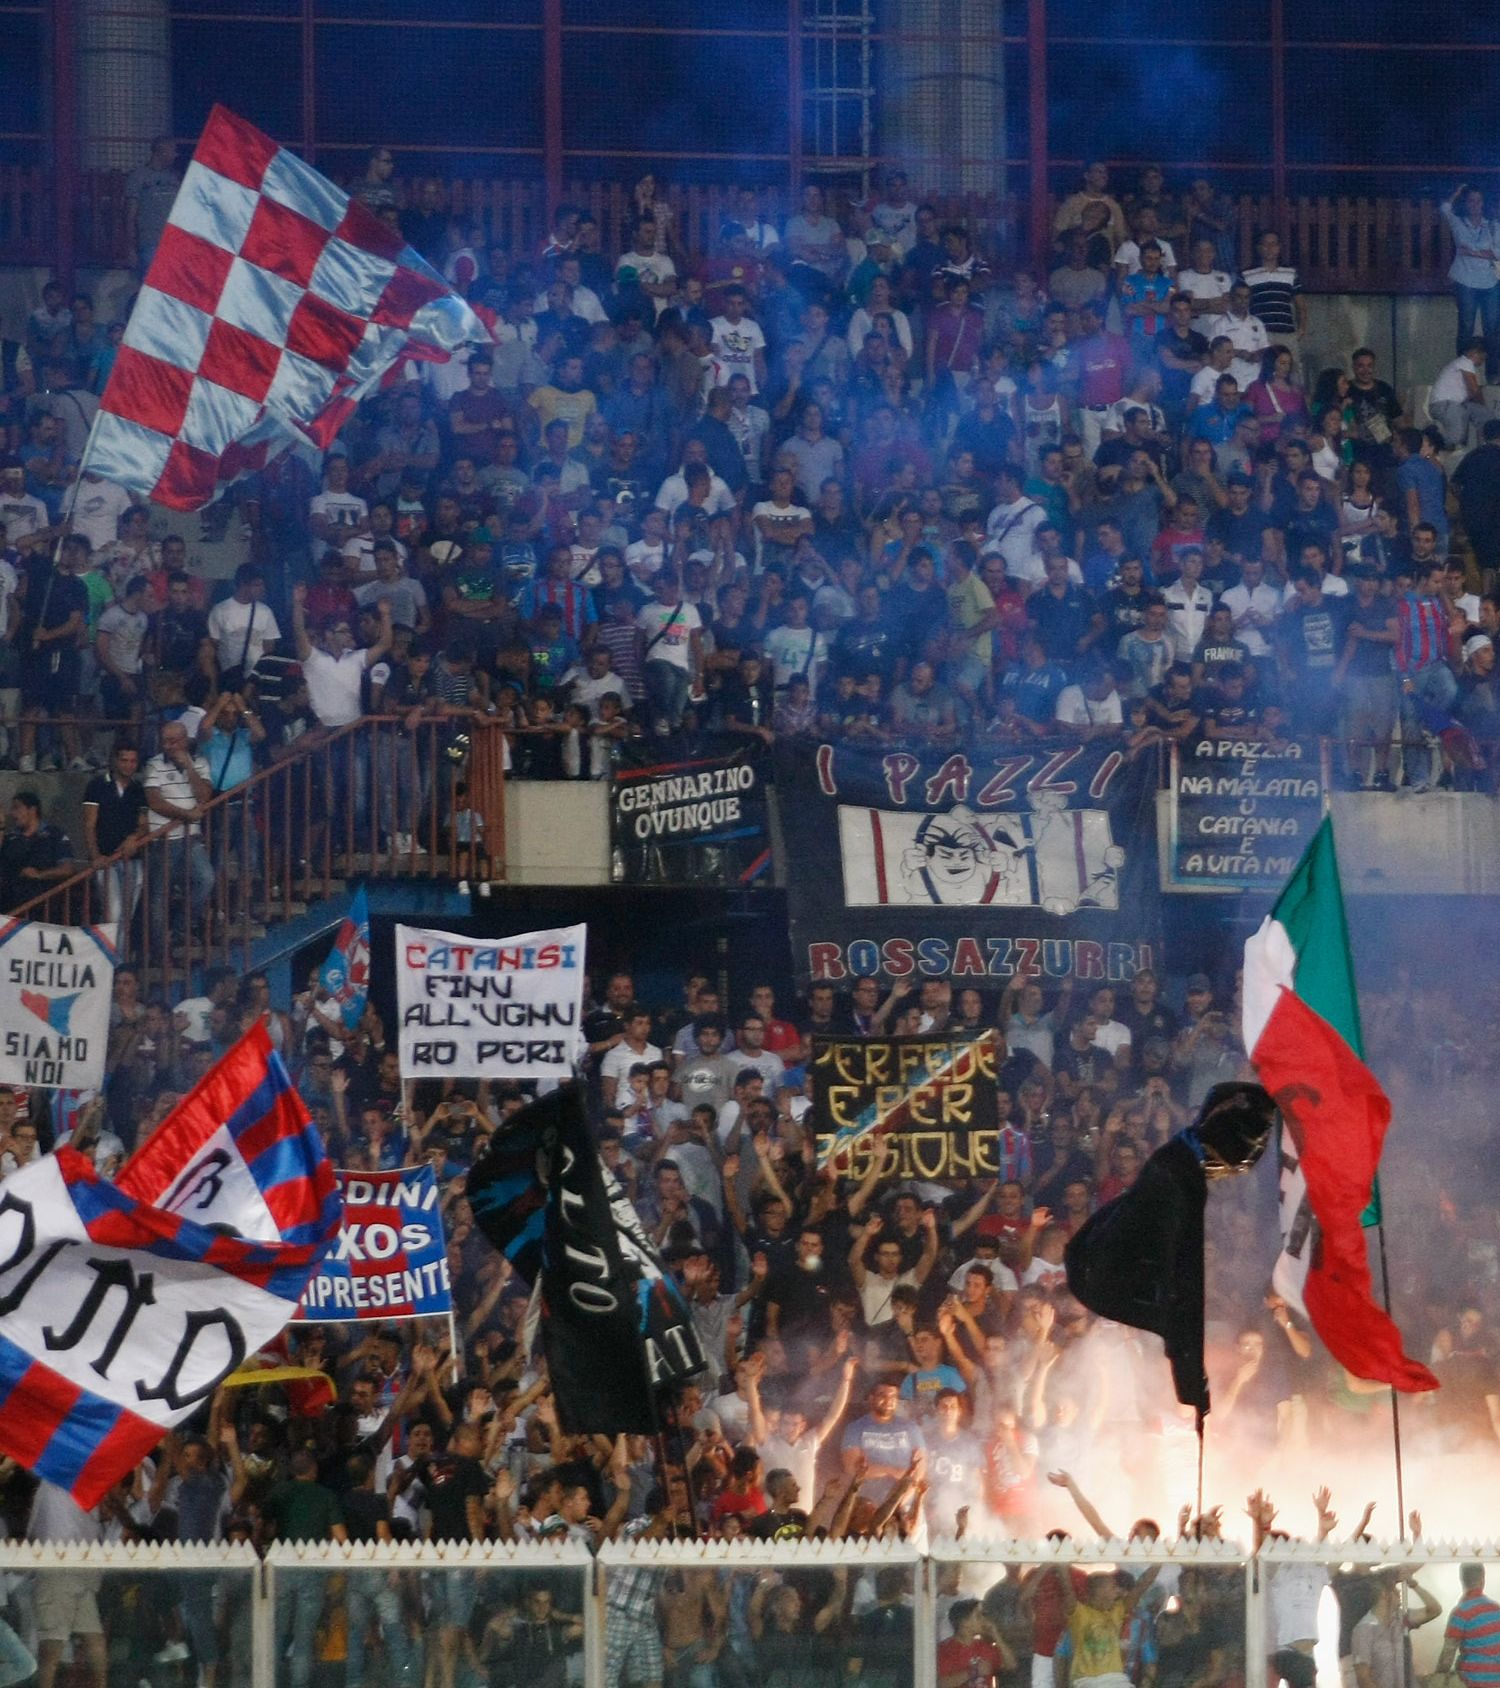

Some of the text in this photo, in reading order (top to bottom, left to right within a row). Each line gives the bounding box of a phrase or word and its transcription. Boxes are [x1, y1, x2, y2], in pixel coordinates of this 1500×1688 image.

[816, 744, 1124, 805] I PAZZI
[1241, 759, 1257, 777] E
[619, 765, 754, 811] GENNARINO
[1180, 776, 1319, 797] NA MALATIA
[635, 797, 741, 838] OVUNQUE
[1199, 815, 1299, 836] CATANIA
[1240, 837, 1256, 854] E
[1263, 856, 1295, 874] MI
[38, 930, 74, 955] LA
[405, 943, 577, 971] CATANISI
[808, 937, 1154, 981] ROSSAZZURRI
[9, 958, 96, 988] SICILIA
[5, 1031, 88, 1062] SIAMO
[413, 1039, 566, 1066] RO PERI
[25, 1060, 65, 1085] NOI
[876, 1082, 974, 1125] PER
[324, 1223, 432, 1261] XOS
